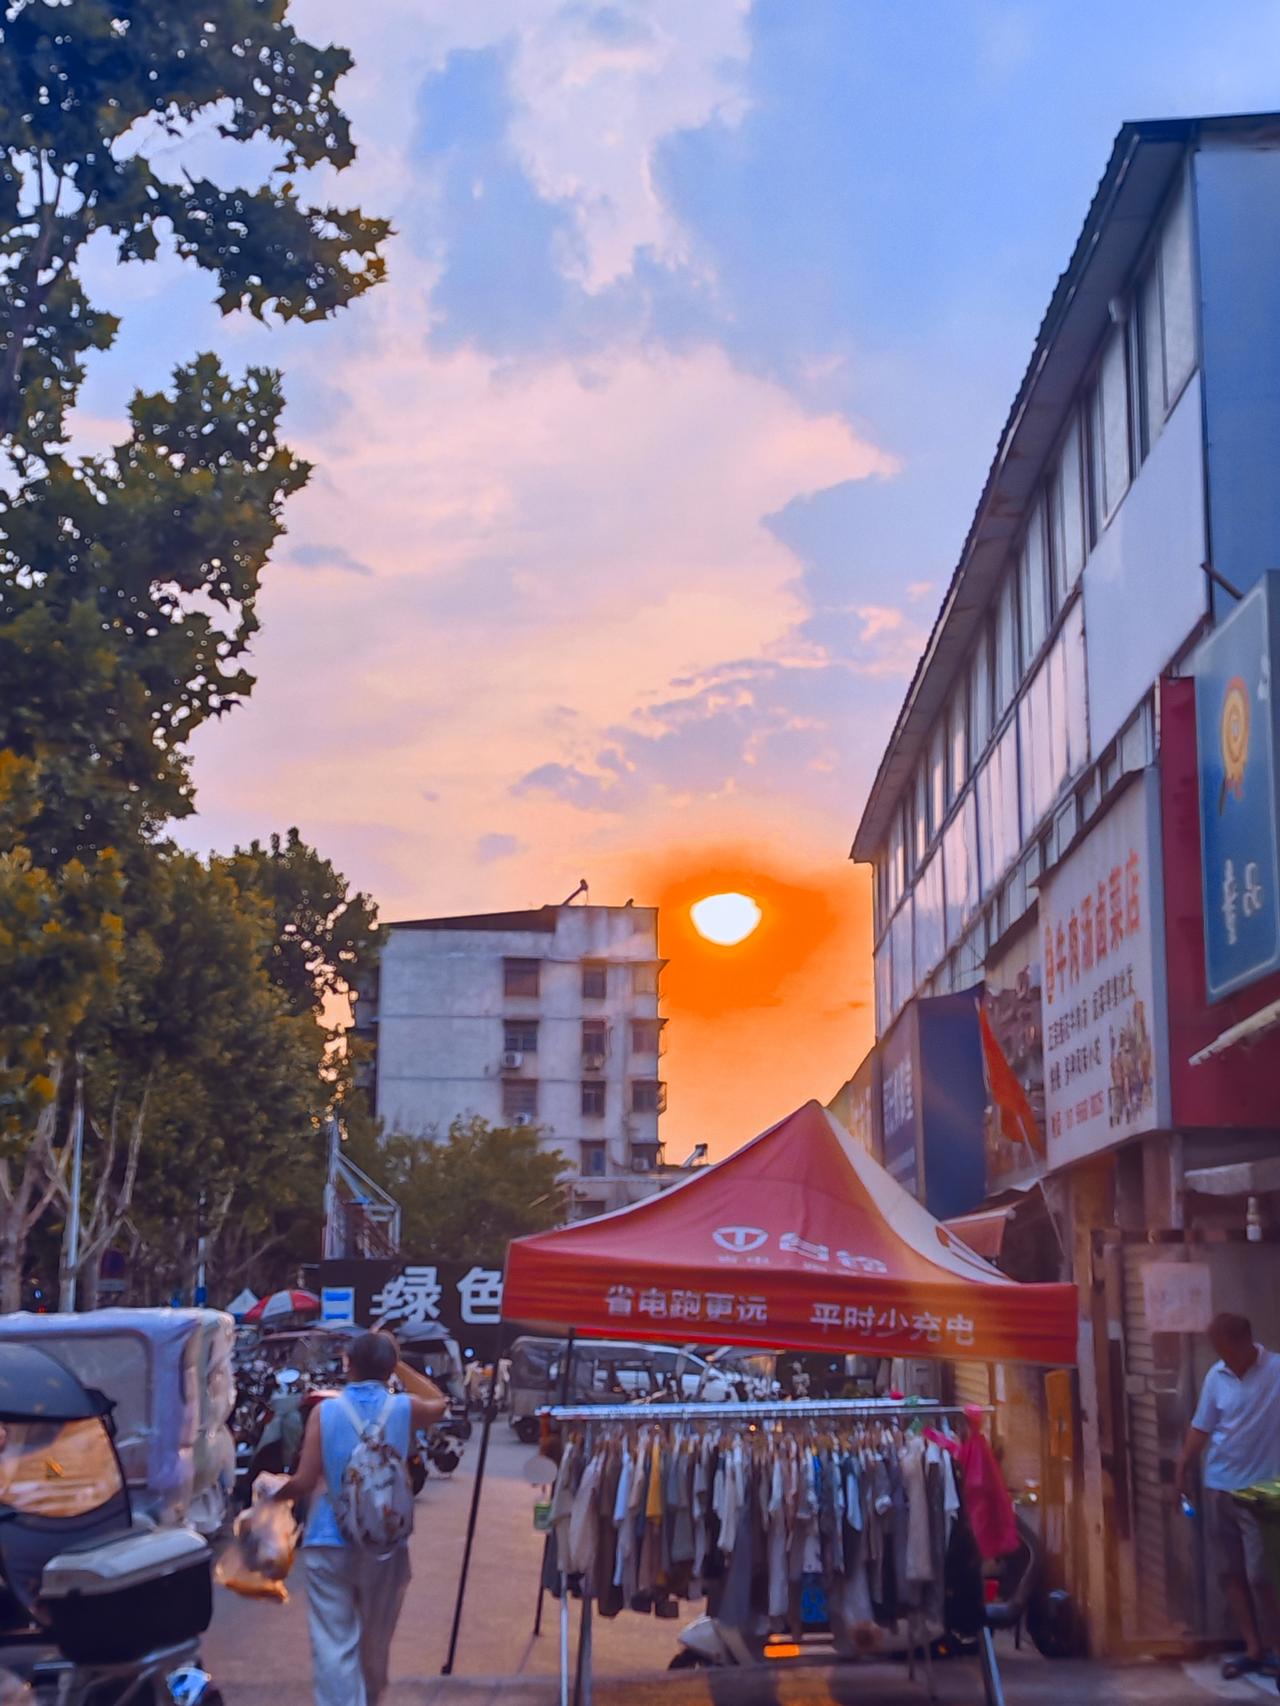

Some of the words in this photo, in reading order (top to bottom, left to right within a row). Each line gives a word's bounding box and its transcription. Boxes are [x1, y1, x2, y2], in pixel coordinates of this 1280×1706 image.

[369, 1265, 504, 1325] 绿色
[605, 1284, 769, 1325] 省电跑更远
[809, 1302, 976, 1346] 平时少充电
